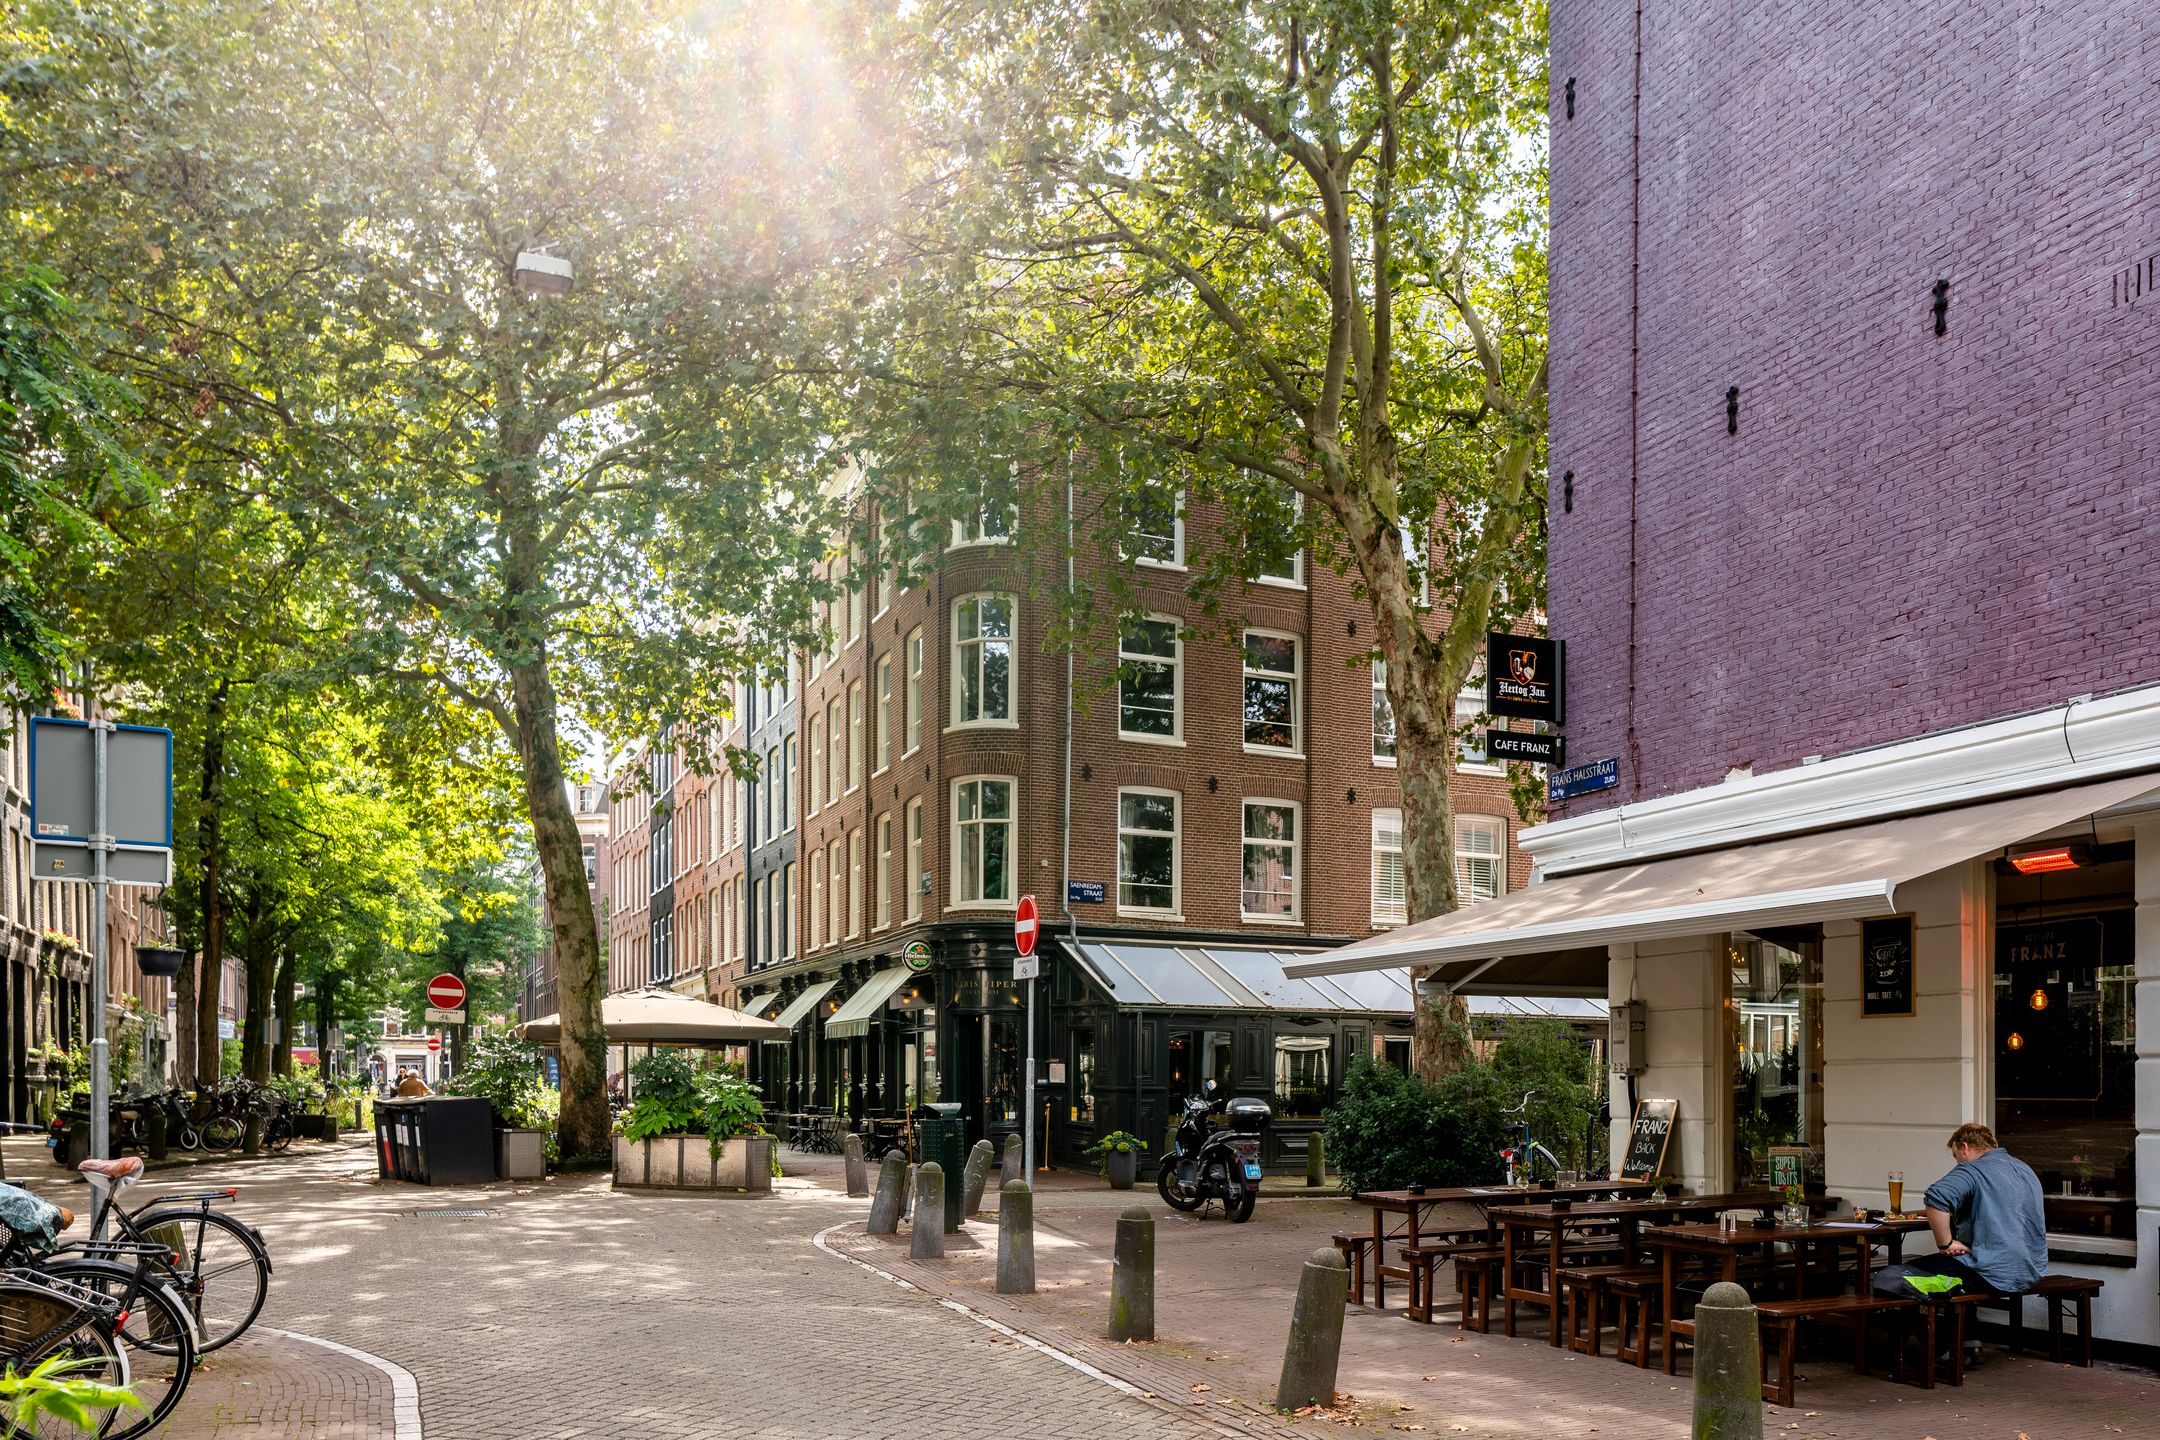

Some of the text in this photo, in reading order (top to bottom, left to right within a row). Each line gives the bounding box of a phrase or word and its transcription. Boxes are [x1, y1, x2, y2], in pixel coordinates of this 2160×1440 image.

[1498, 681, 1546, 699] Hertog Jan
[1494, 739, 1551, 755] CAFE FRANZ
[1551, 761, 1615, 788] FRANS HALSSTRAAT
[1070, 881, 1104, 890] SAENREDAM-
[1083, 889, 1104, 897] STRAAT
[2011, 942, 2066, 963] FRANZ
[1634, 1119, 1670, 1135] FRANZ
[1635, 1141, 1657, 1154] BACK
[1775, 1155, 1796, 1171] SUPER
